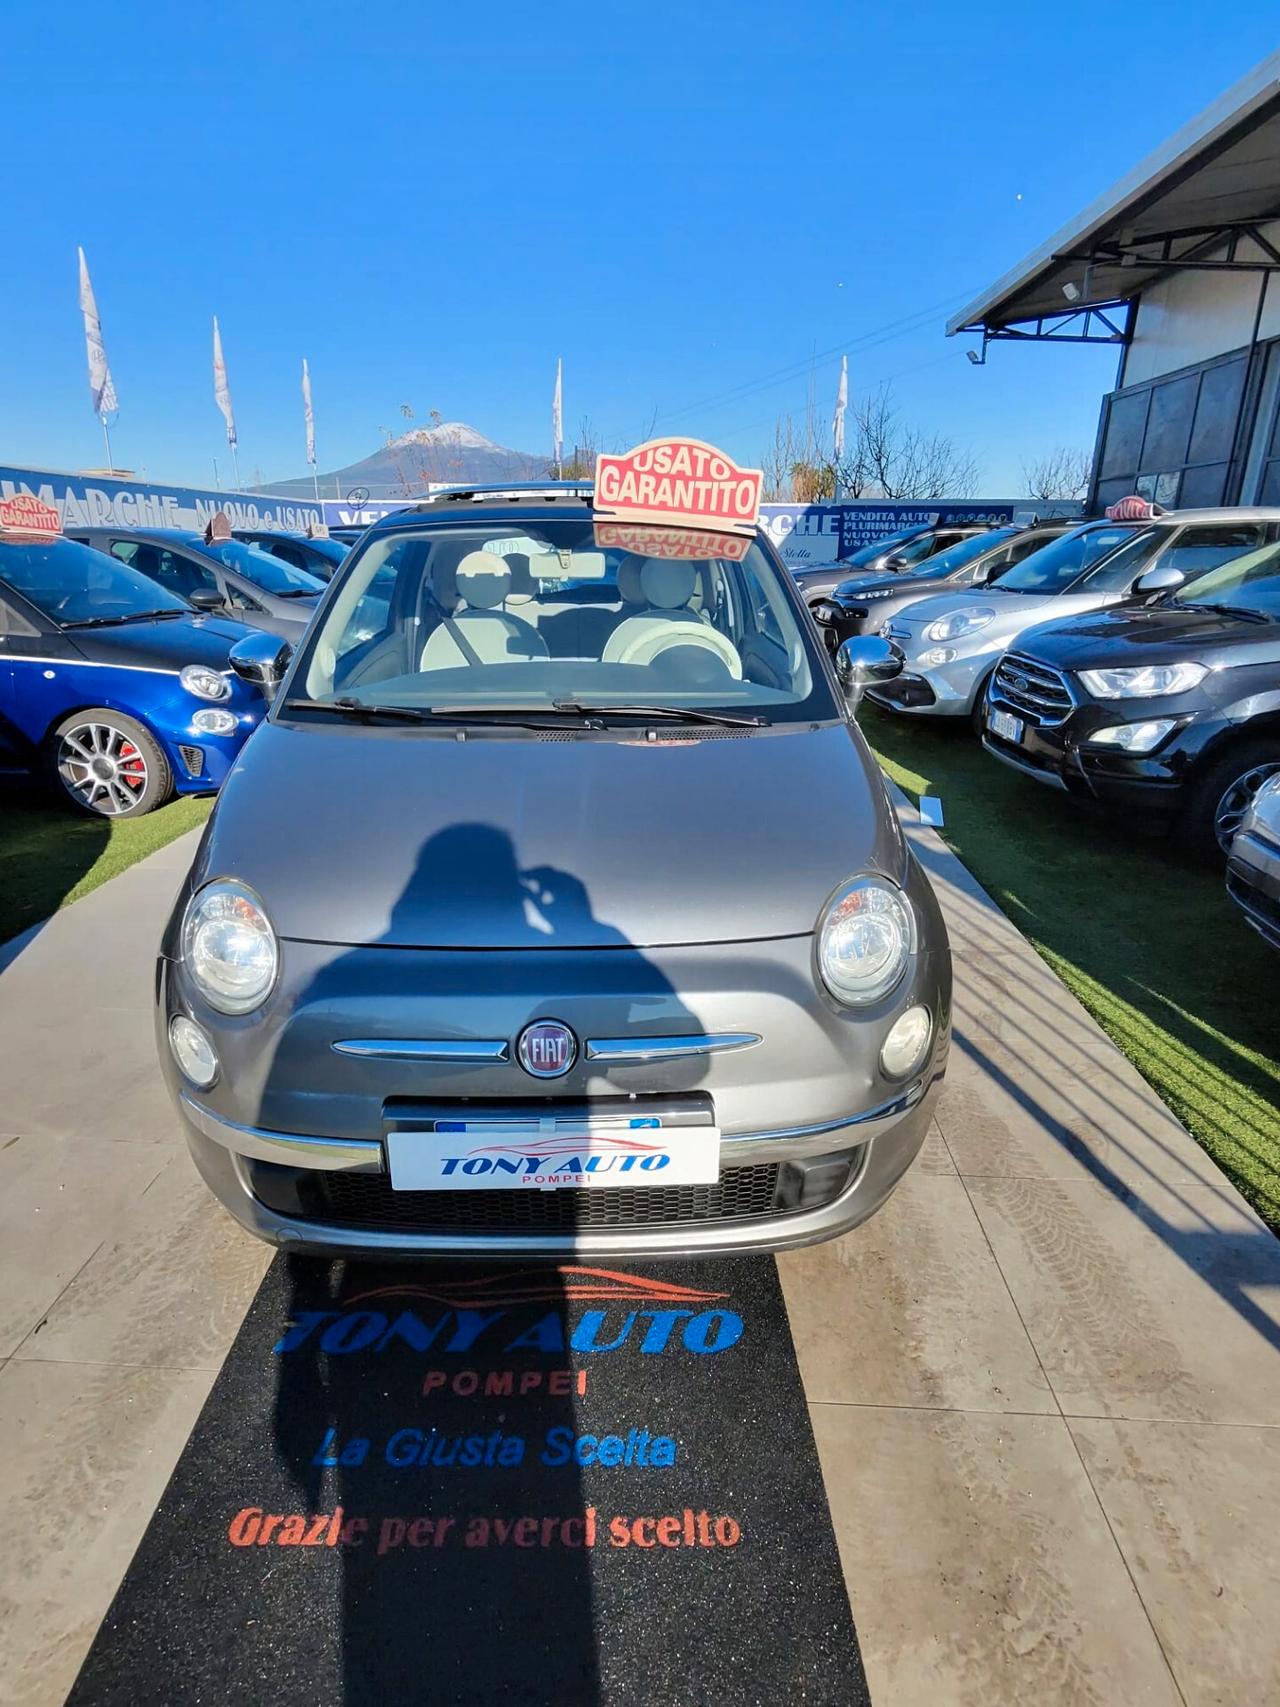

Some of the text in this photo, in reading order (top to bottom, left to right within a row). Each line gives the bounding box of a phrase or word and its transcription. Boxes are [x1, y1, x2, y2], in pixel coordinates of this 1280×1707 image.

[633, 446, 731, 480] USATO
[600, 464, 756, 515] GARANTITO
[1, 505, 60, 530] GARANTITO
[10, 497, 48, 514] USATO
[263, 511, 273, 530] e
[276, 506, 320, 531] USATO
[843, 511, 895, 521] VENDITA
[532, 1037, 565, 1063] FIAT
[440, 1154, 671, 1175] TONY AUTO
[521, 1174, 591, 1184] POMPEI
[273, 1309, 745, 1355] TONY AUTO
[421, 1369, 588, 1397] POMPEI
[310, 1425, 679, 1468] La Giusta Scelta
[227, 1506, 742, 1556] Grazie per averci scelto
